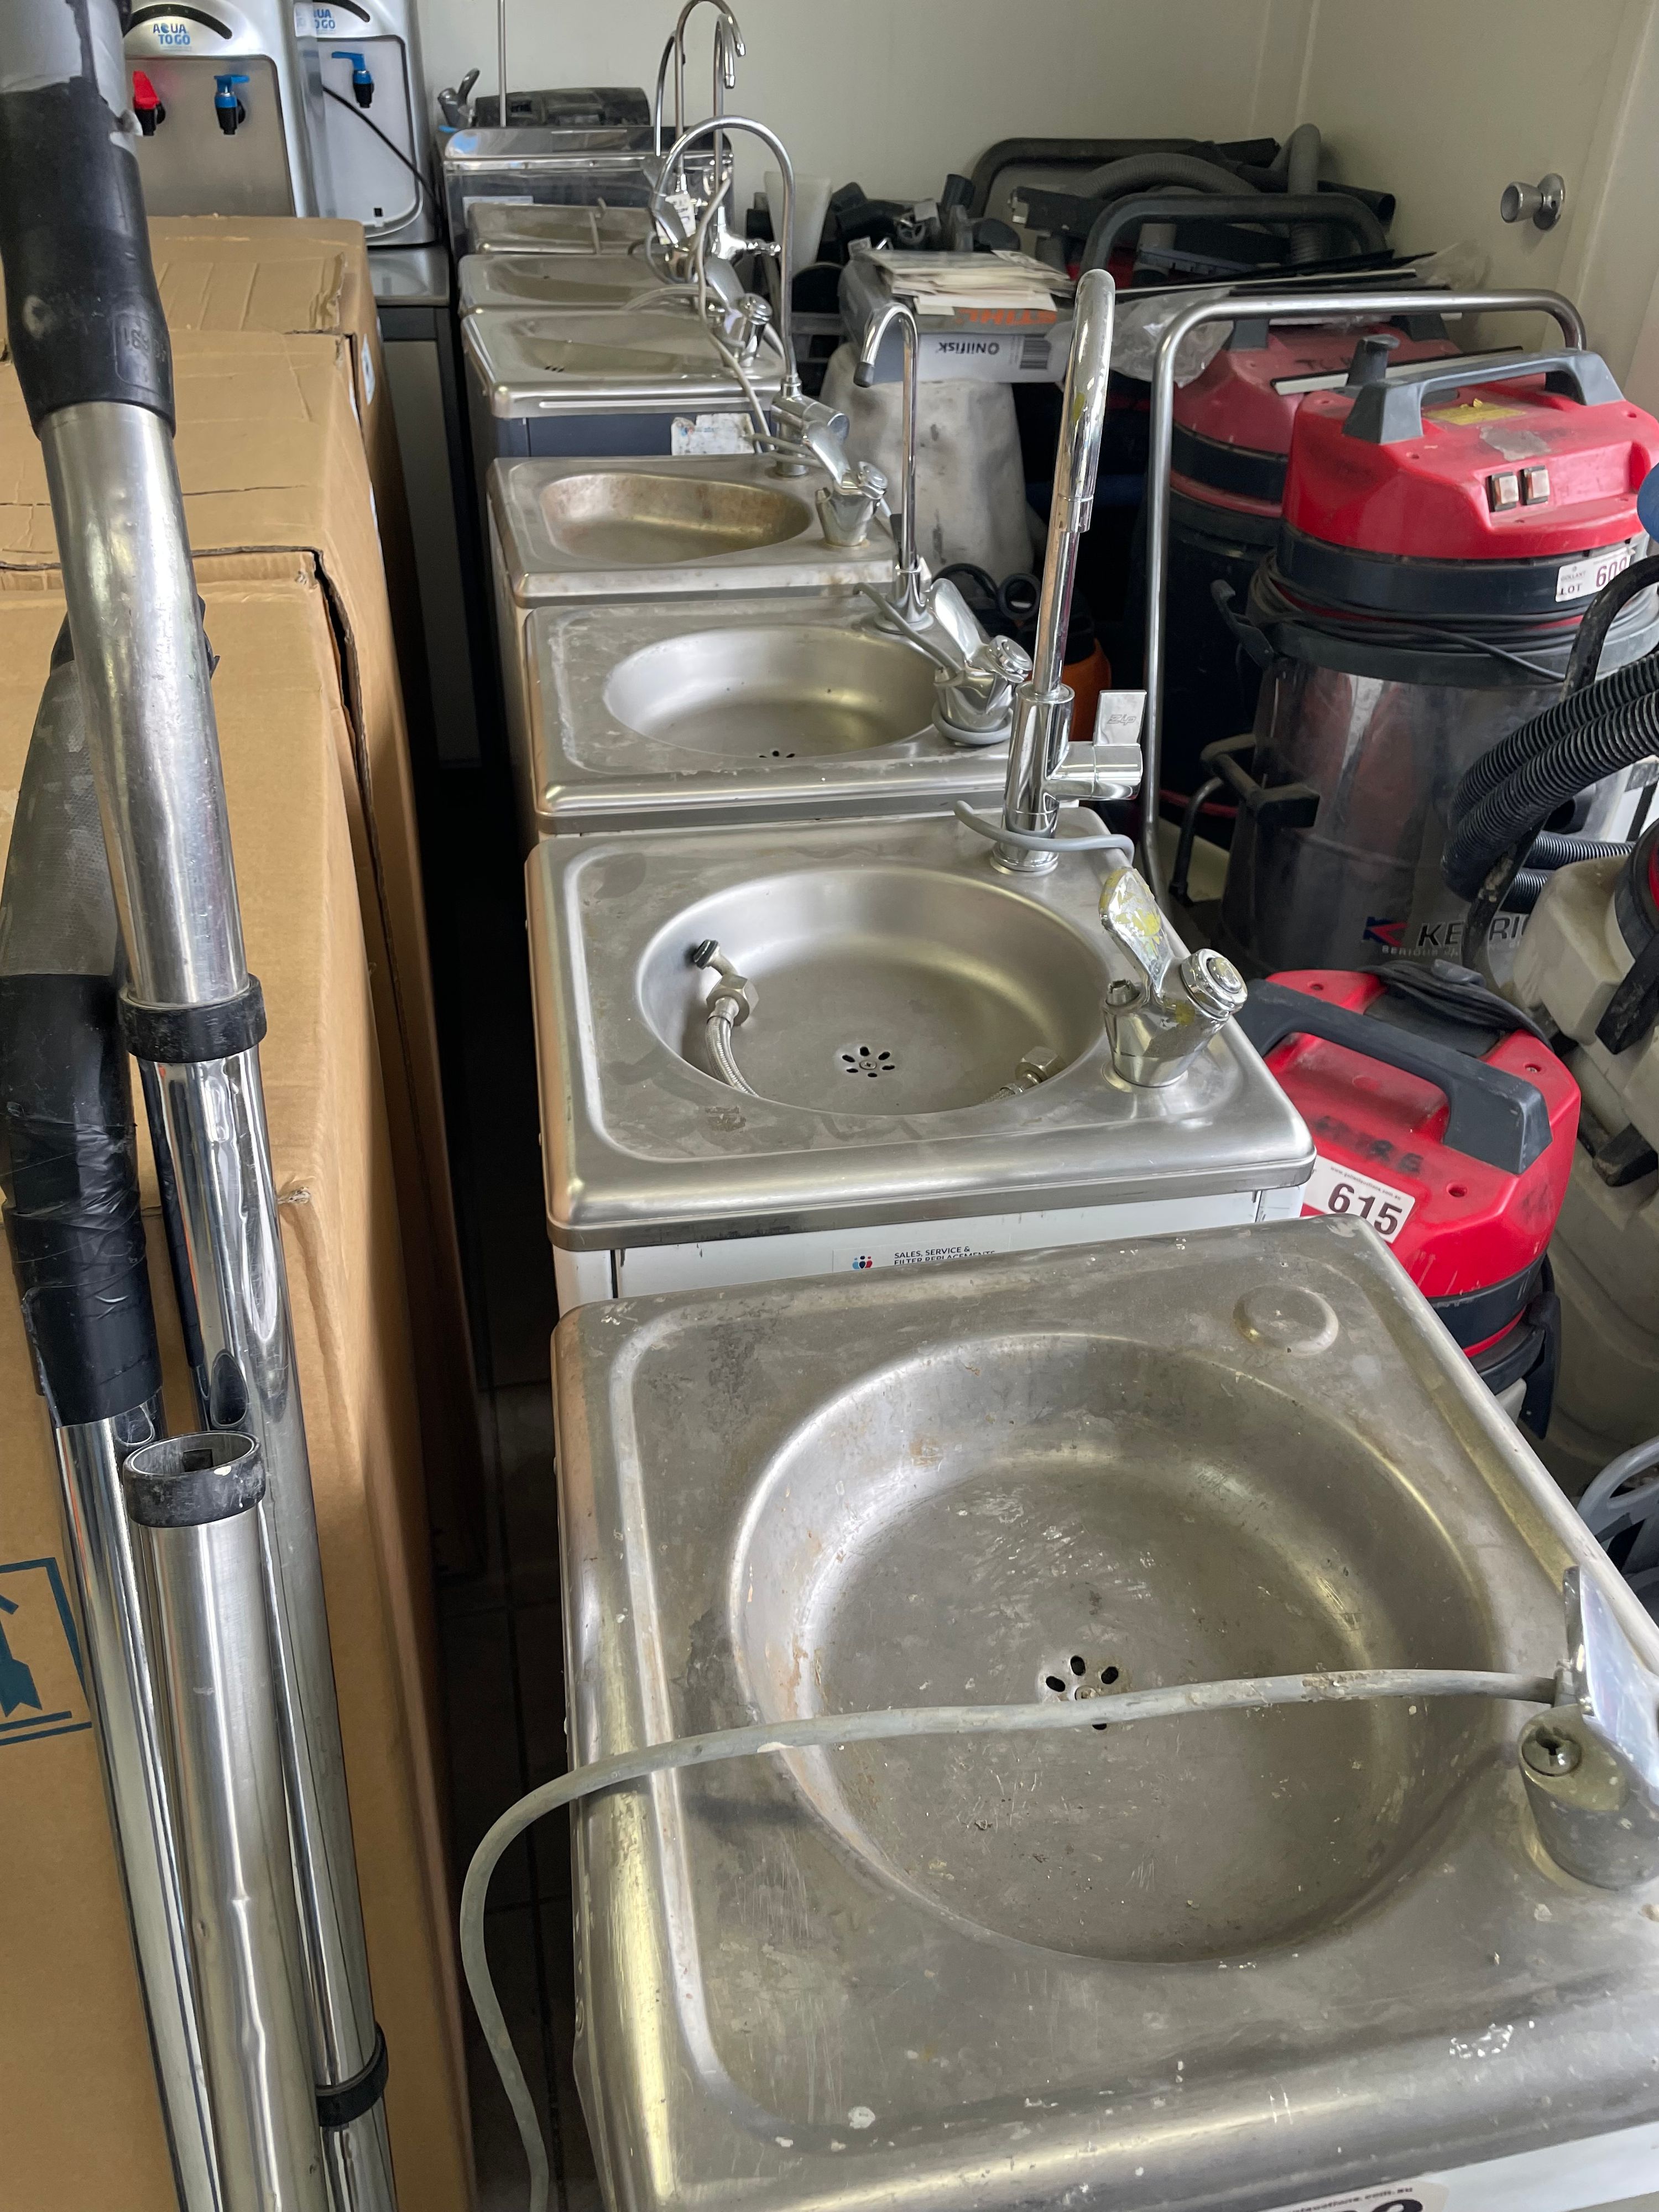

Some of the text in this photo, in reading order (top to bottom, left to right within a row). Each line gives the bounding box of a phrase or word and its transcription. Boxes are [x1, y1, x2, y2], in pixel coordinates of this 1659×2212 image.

[153, 23, 187, 33] AQUA
[958, 309, 1057, 325] STIHL
[1559, 583, 1583, 596] LOT
[1418, 915, 1530, 947] KERI
[1328, 1183, 1403, 1235] 615
[894, 1250, 923, 1259] SALES,
[925, 1246, 962, 1256] SERVICE
